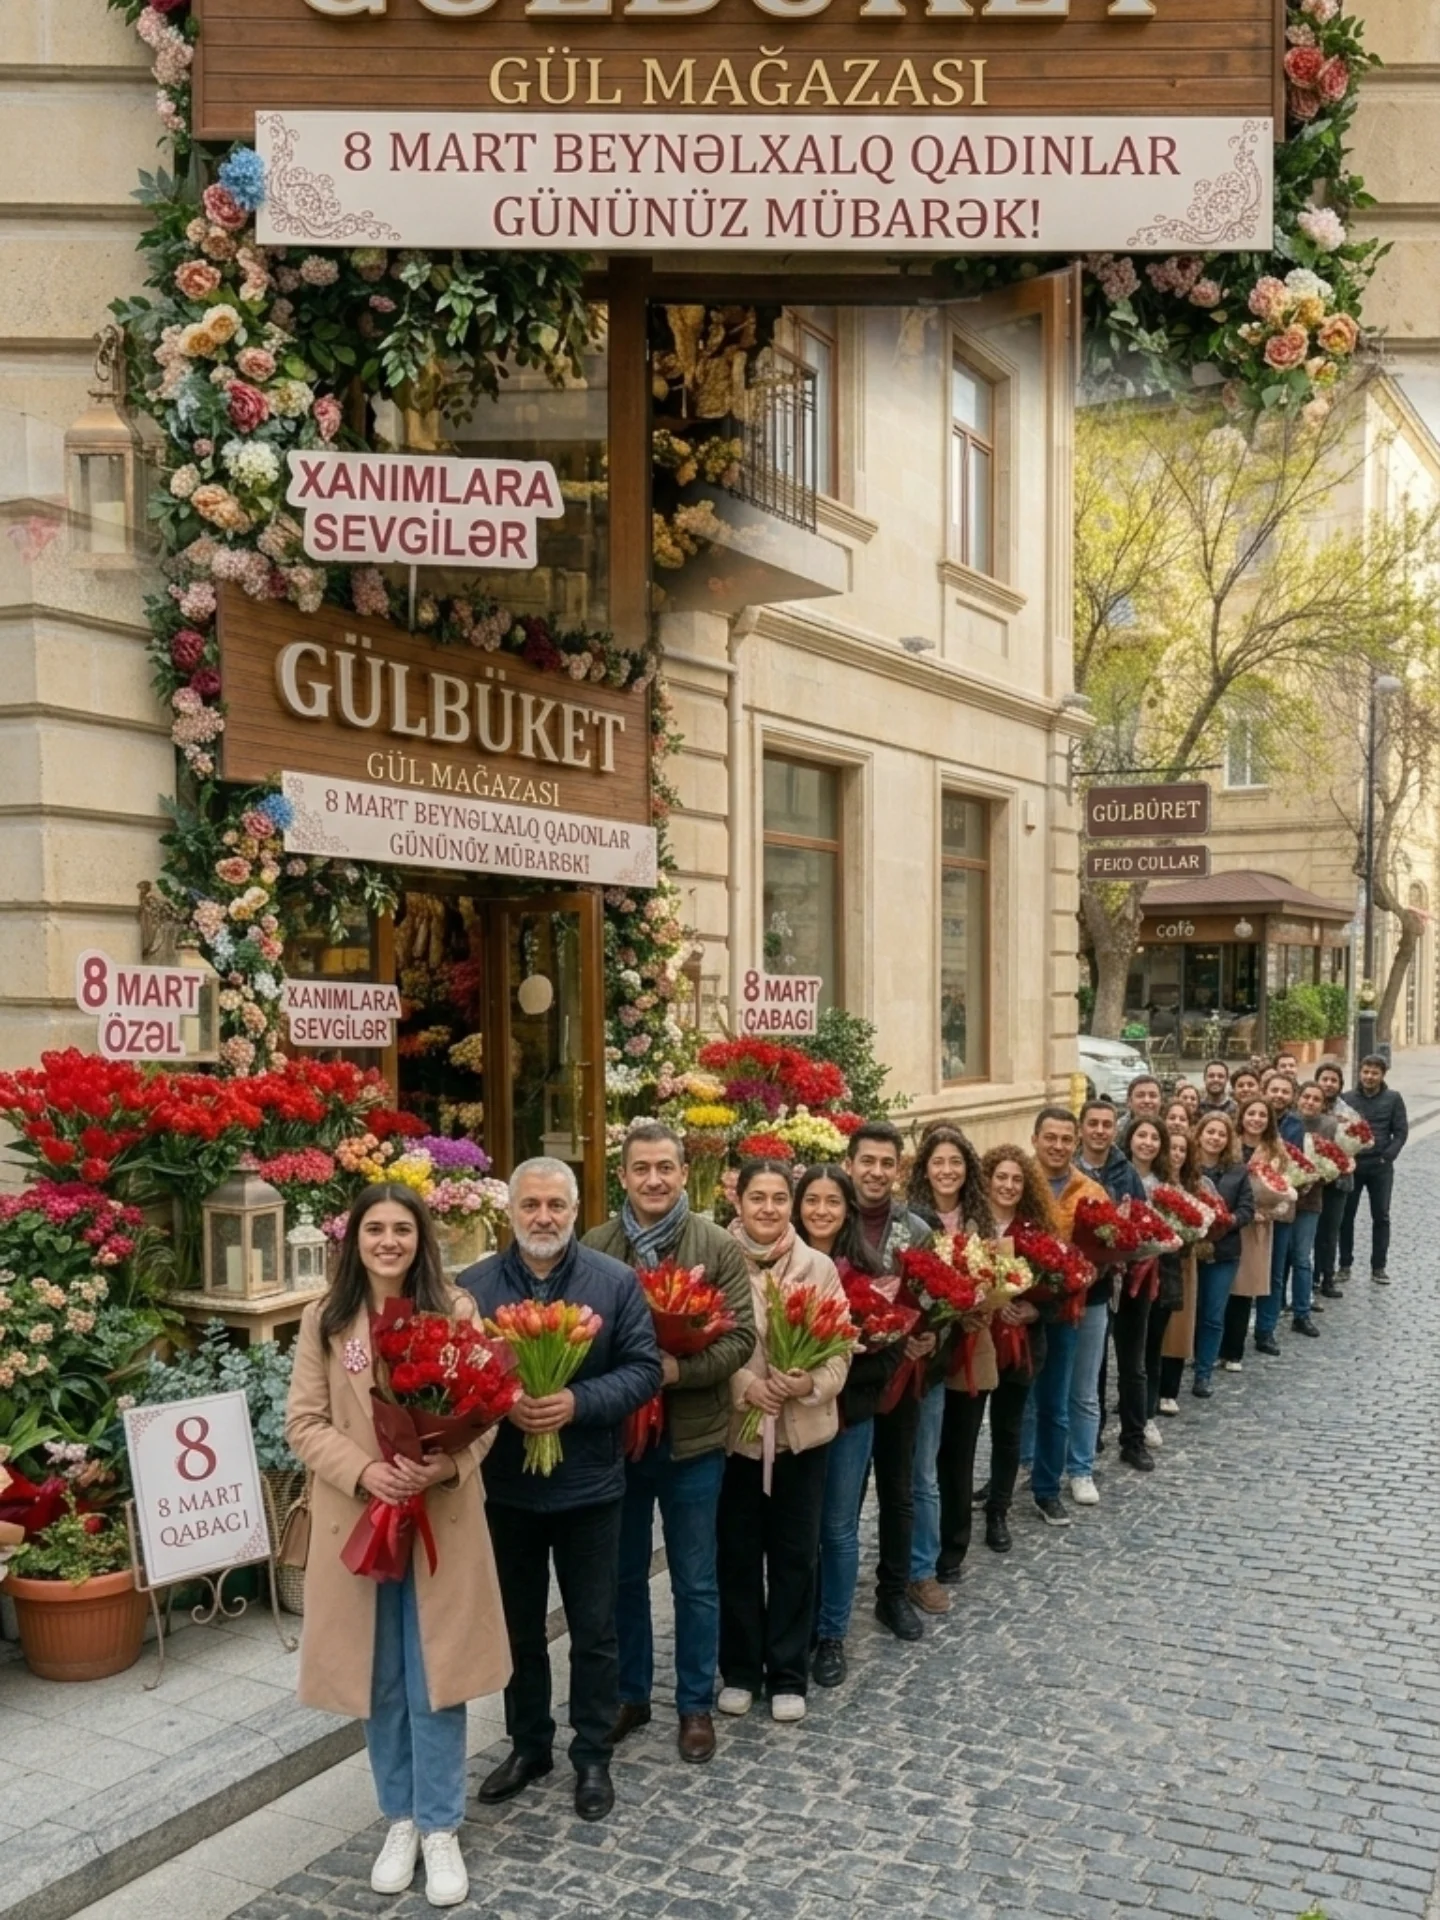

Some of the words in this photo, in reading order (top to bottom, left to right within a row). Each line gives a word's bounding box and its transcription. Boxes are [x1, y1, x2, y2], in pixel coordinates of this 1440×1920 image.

[488, 46, 622, 105] GÜL
[641, 46, 989, 106] MAĞAZASI
[343, 130, 372, 172] 8
[388, 131, 537, 173] MART
[552, 132, 895, 184] BEYNƏLXALQ
[909, 134, 1181, 184] QADINLAR
[493, 187, 748, 238] GÜNÜNÜZ
[765, 187, 1041, 240] MÜBARƏK!
[298, 459, 554, 508] XANIMLARA
[313, 509, 528, 560] SEVGİLƏR
[278, 632, 626, 773] GÜLBÜKET
[366, 750, 425, 786] GÜL
[431, 761, 561, 807] MAĞAZASI
[325, 789, 338, 813] 8
[345, 791, 409, 822] MART
[82, 956, 108, 1008] 8
[117, 972, 200, 1009] MART
[287, 984, 399, 1012] XANIMLARA
[743, 969, 760, 1003] 8
[764, 979, 820, 1004] MART
[104, 1011, 181, 1054] ÖZƏL
[175, 1415, 217, 1481] 8
[157, 1497, 172, 1518] 8
[178, 1482, 243, 1515] MART
